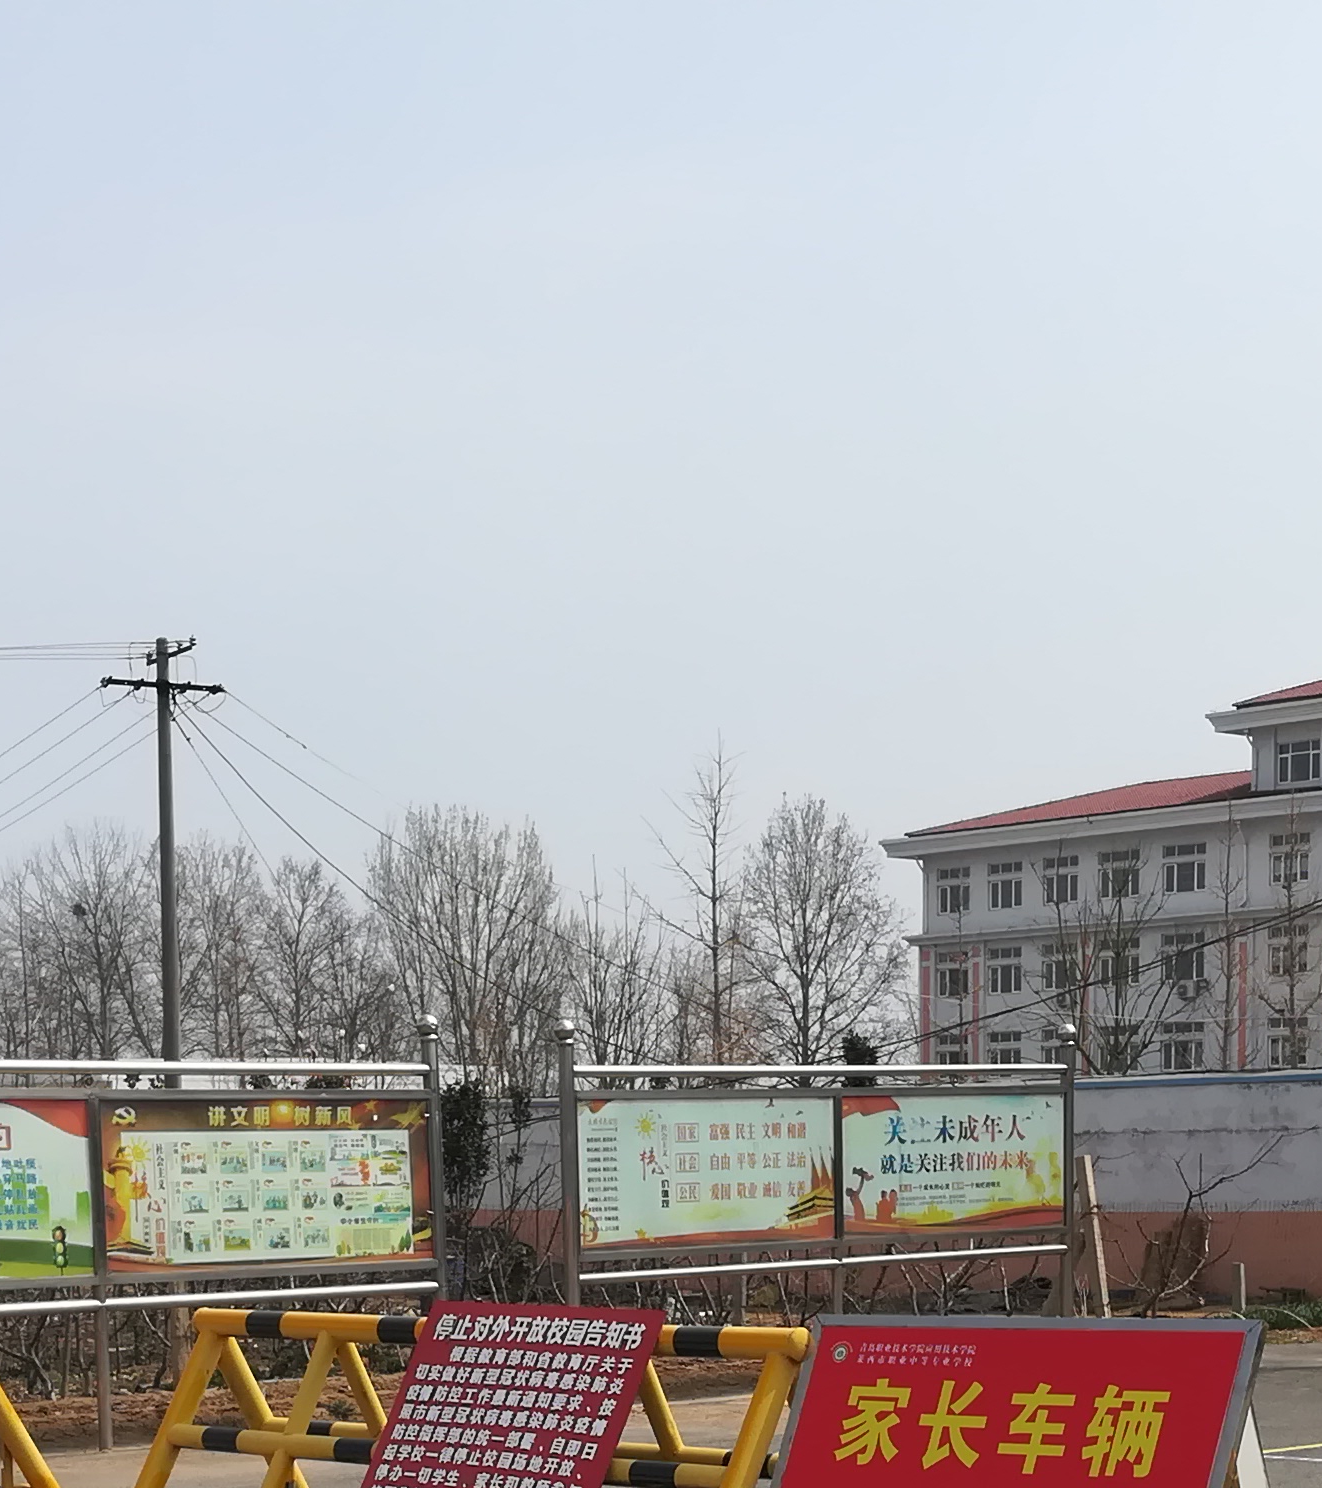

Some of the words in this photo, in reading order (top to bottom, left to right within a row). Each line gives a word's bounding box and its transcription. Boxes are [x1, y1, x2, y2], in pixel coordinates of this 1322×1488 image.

[208, 1106, 271, 1127] 讲文明
[294, 1106, 352, 1126] 树新风
[677, 1125, 696, 1141] 国家
[709, 1123, 731, 1141] 富强
[736, 1122, 755, 1140] 民主
[762, 1122, 782, 1139] 文明
[787, 1122, 806, 1139] 和谐
[155, 1143, 166, 1190] 社会主义
[678, 1155, 697, 1171] 社会
[710, 1153, 731, 1171] 自由
[737, 1152, 757, 1169] 平等
[762, 1152, 782, 1169] 公正
[786, 1151, 806, 1168] 法治
[880, 1150, 1030, 1175] 就是关注我们的未来
[679, 1185, 697, 1200] 公民
[709, 1183, 731, 1200] 爱国
[737, 1182, 758, 1199] 敬业
[762, 1181, 782, 1198] 诚信
[787, 1181, 806, 1198] 友善
[433, 1314, 646, 1351] 停止对外开放校园告知书
[449, 1346, 634, 1375] 根据教育部和省教育厅关于
[415, 1363, 625, 1395] 切实做好新型冠状病毒感染肺炎
[398, 1404, 609, 1437] 照市新型冠状病毒感染肺炎疫情
[833, 1378, 1171, 1478] 家长车辆
